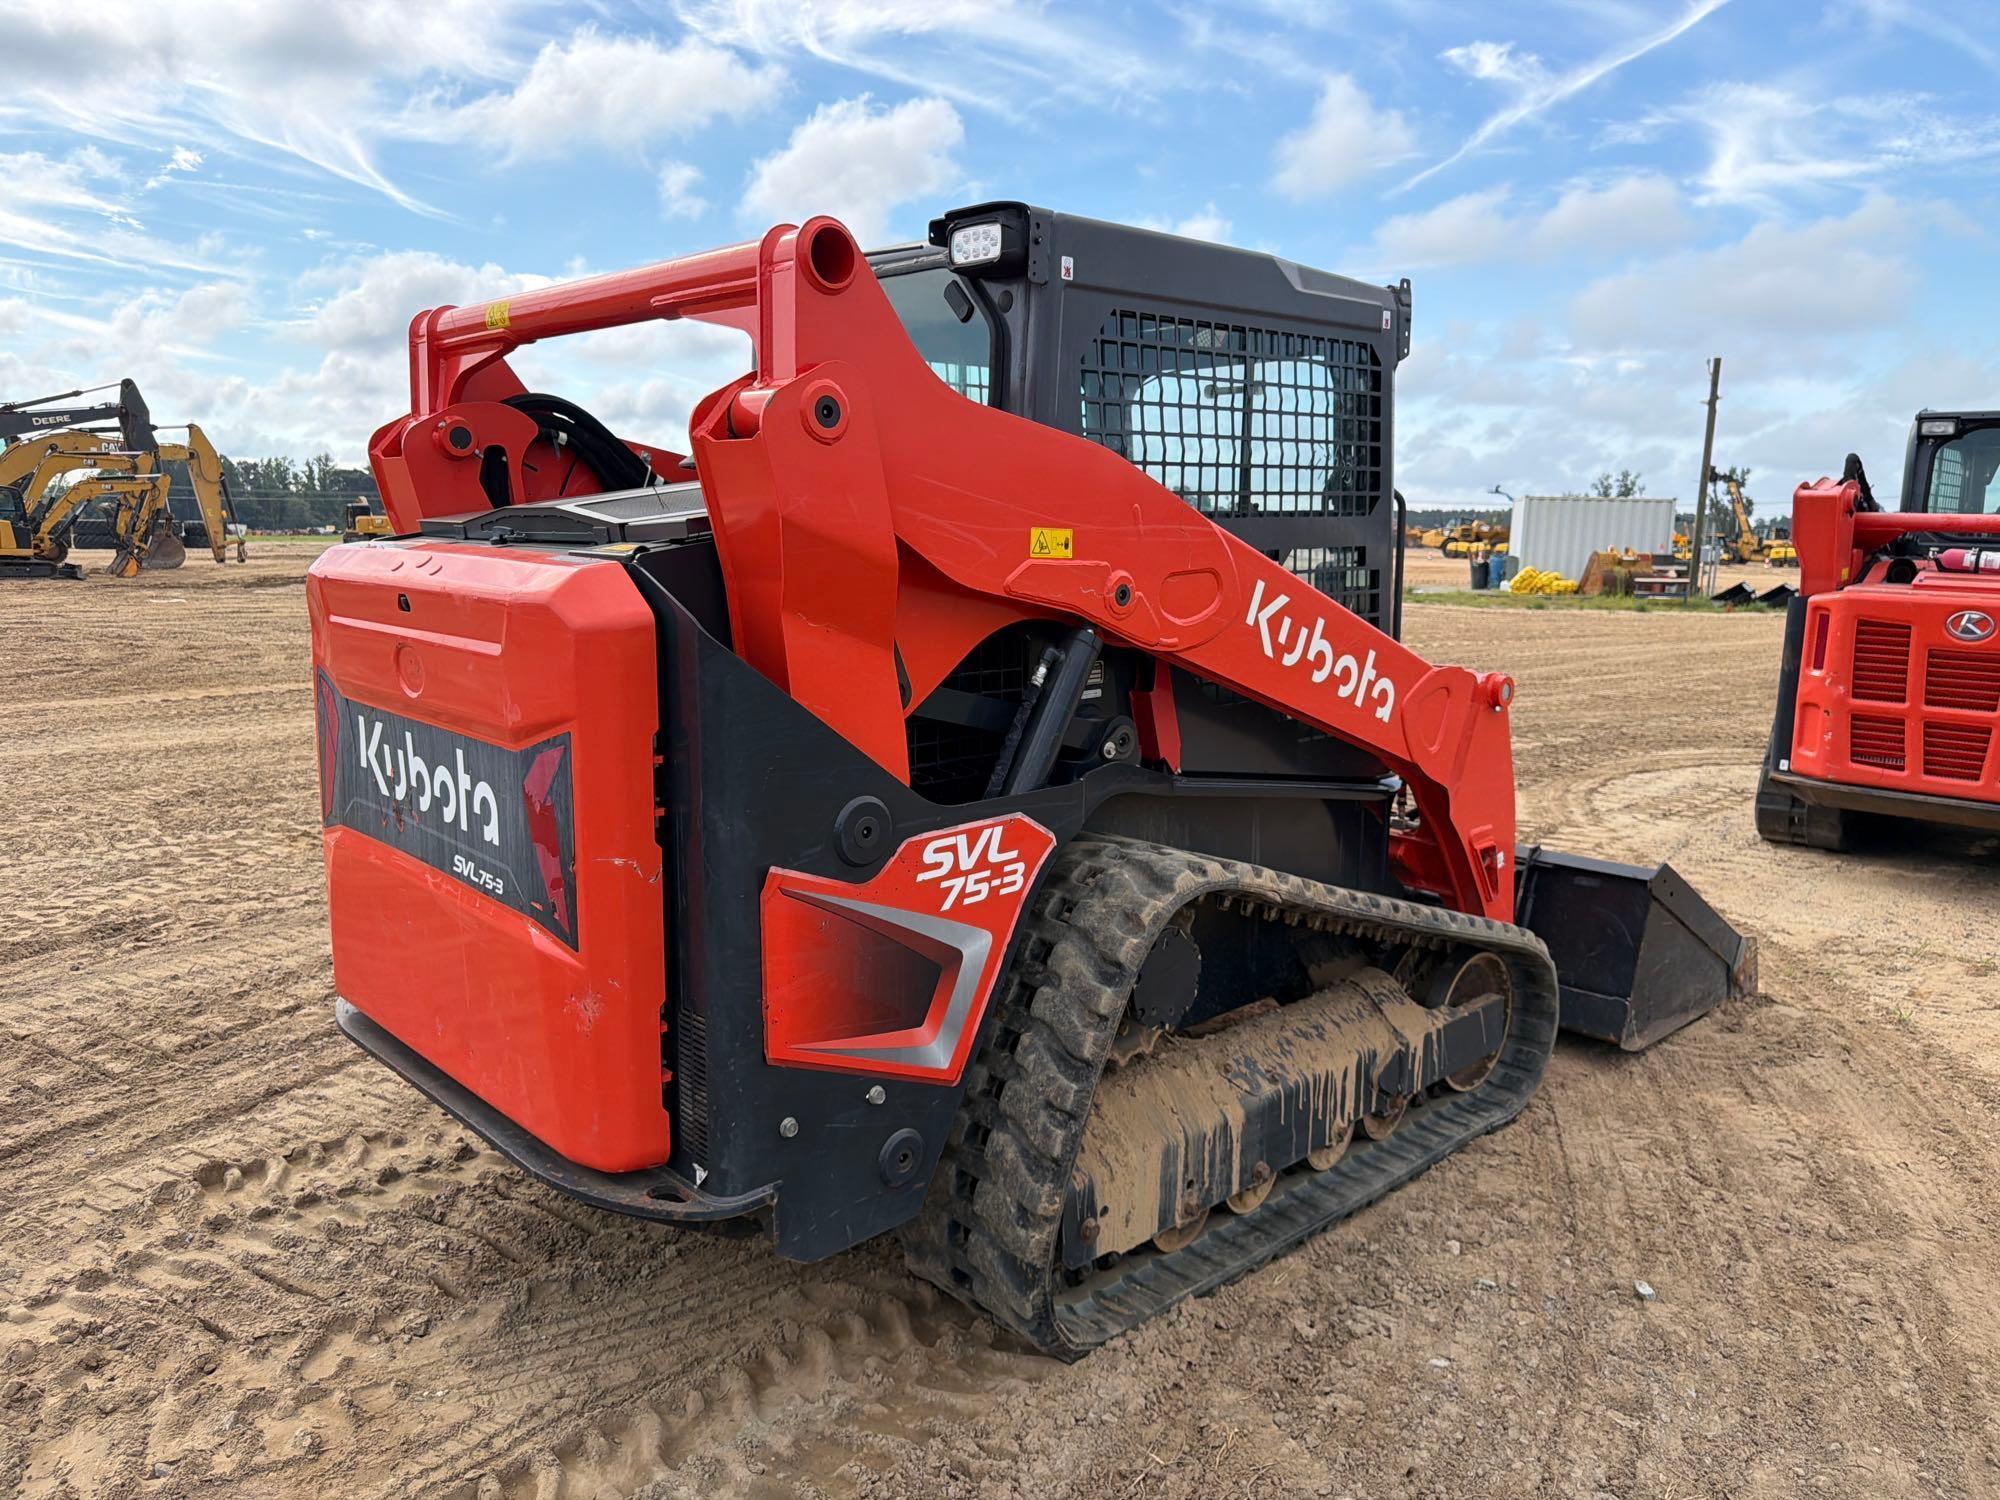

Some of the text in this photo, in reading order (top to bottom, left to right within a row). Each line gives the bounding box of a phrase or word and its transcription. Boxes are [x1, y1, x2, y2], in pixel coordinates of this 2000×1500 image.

[32, 414, 71, 426] DEERE
[1245, 578, 1396, 723] Kubota
[358, 715, 500, 846] Kubota
[453, 854, 504, 895] SVL75-3
[916, 825, 1019, 882] SVL
[940, 861, 1026, 912] 75-3
